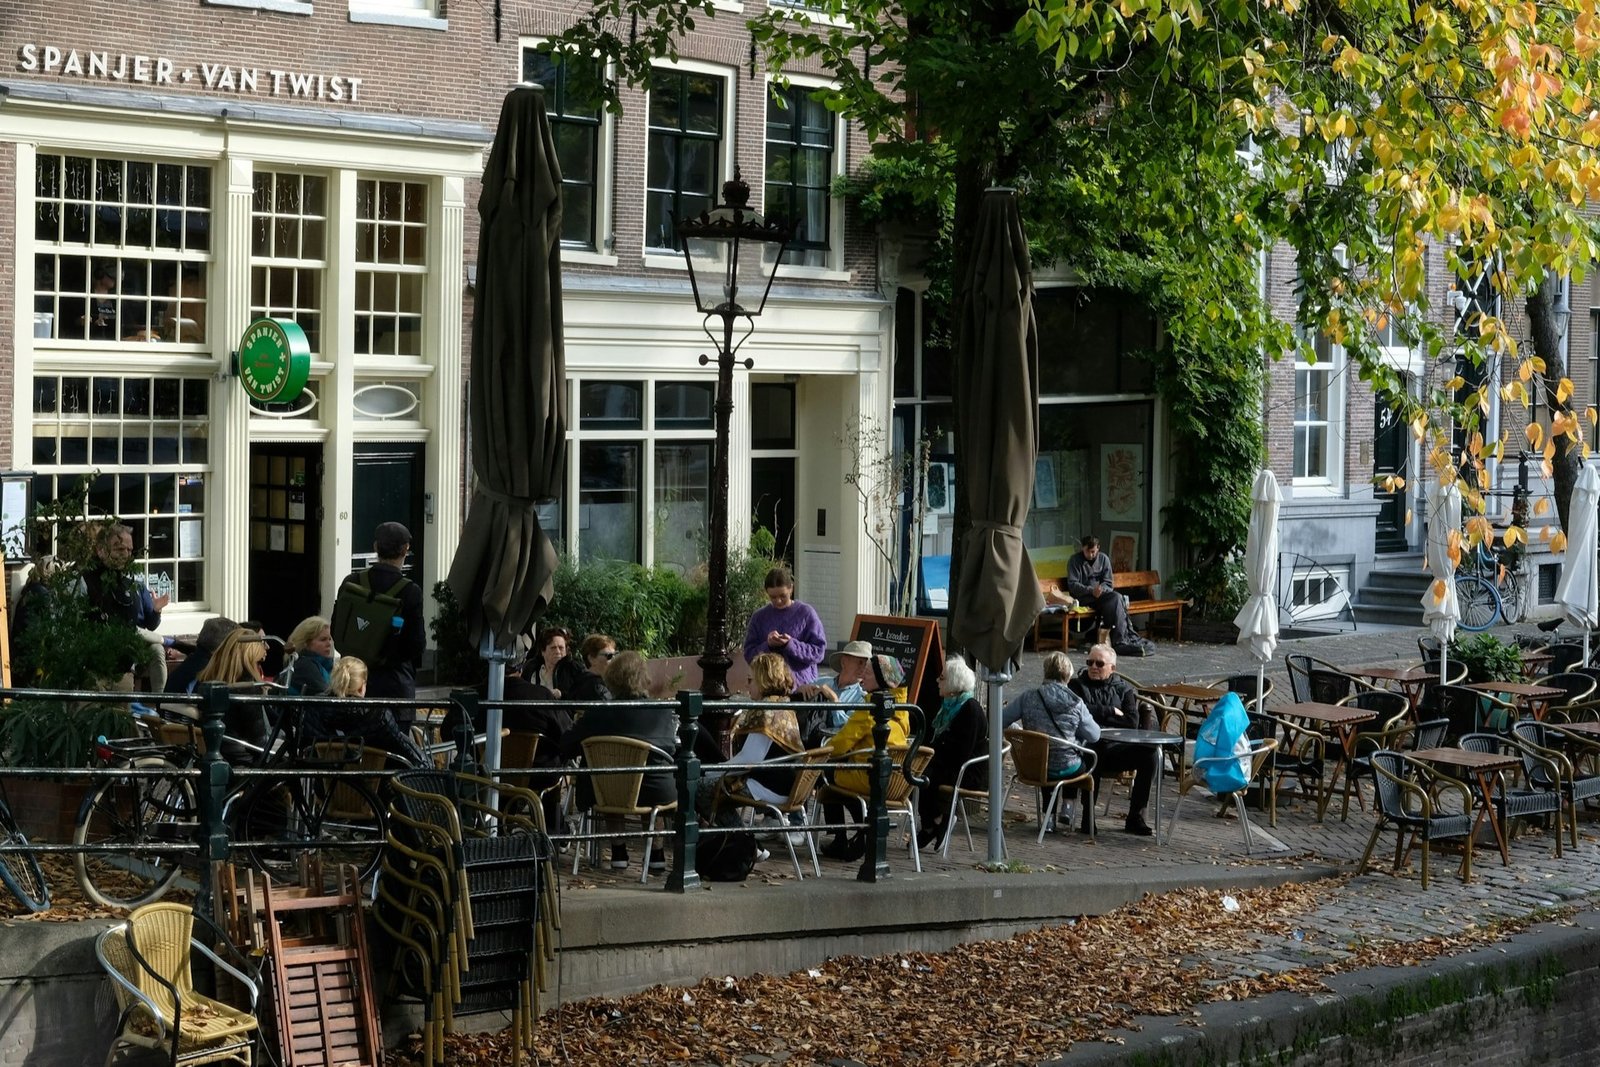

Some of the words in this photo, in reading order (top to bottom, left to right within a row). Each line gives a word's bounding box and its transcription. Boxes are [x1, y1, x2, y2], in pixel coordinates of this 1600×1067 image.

[21, 43, 173, 84] SPANJER
[182, 69, 192, 82] +
[202, 63, 258, 92] VAN
[270, 70, 362, 101] TWIST
[246, 327, 283, 349] SPANJER
[244, 367, 258, 390] VAN
[260, 367, 284, 394] TWIST
[1380, 407, 1392, 429] 54
[340, 512, 348, 520] 60
[874, 627, 884, 638] De
